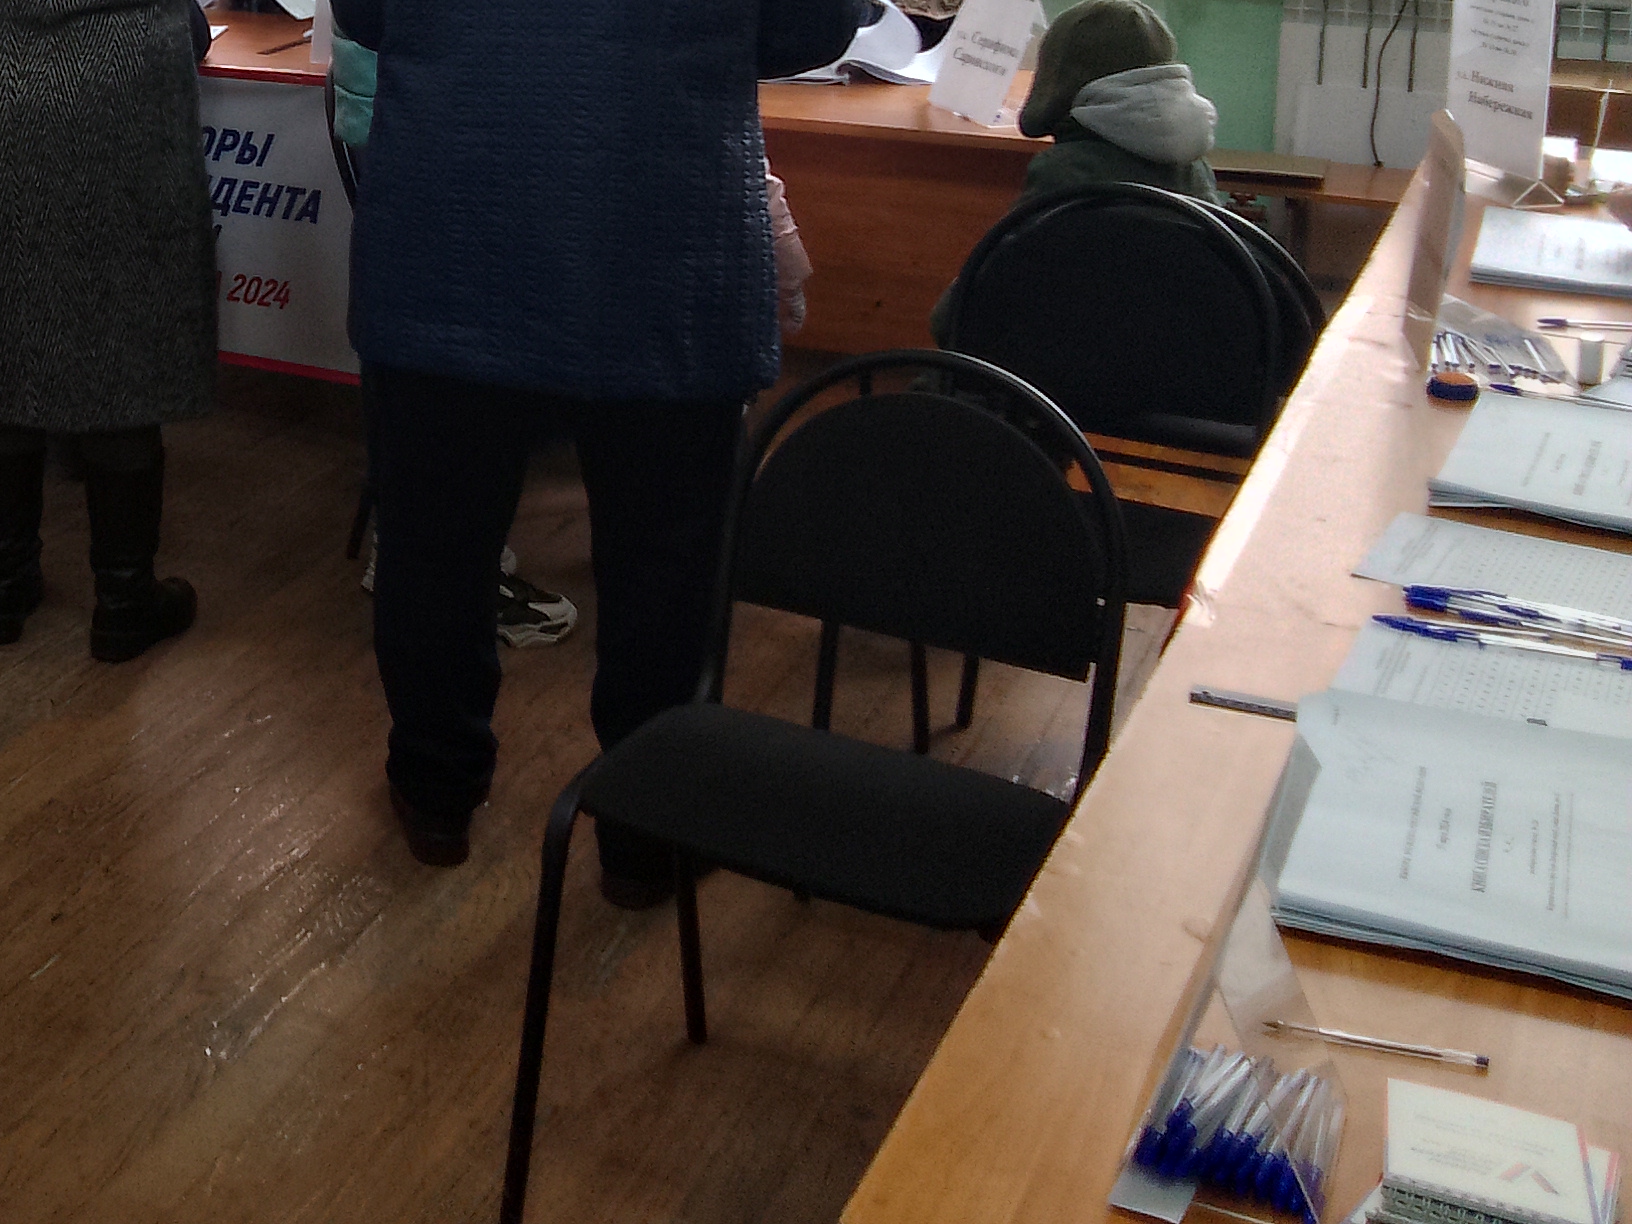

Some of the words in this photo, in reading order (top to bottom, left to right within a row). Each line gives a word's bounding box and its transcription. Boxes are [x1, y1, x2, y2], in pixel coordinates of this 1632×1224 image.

[202, 126, 275, 167] ОРЫ
[209, 175, 322, 224] ДЕНТА
[226, 273, 290, 310] 2024
